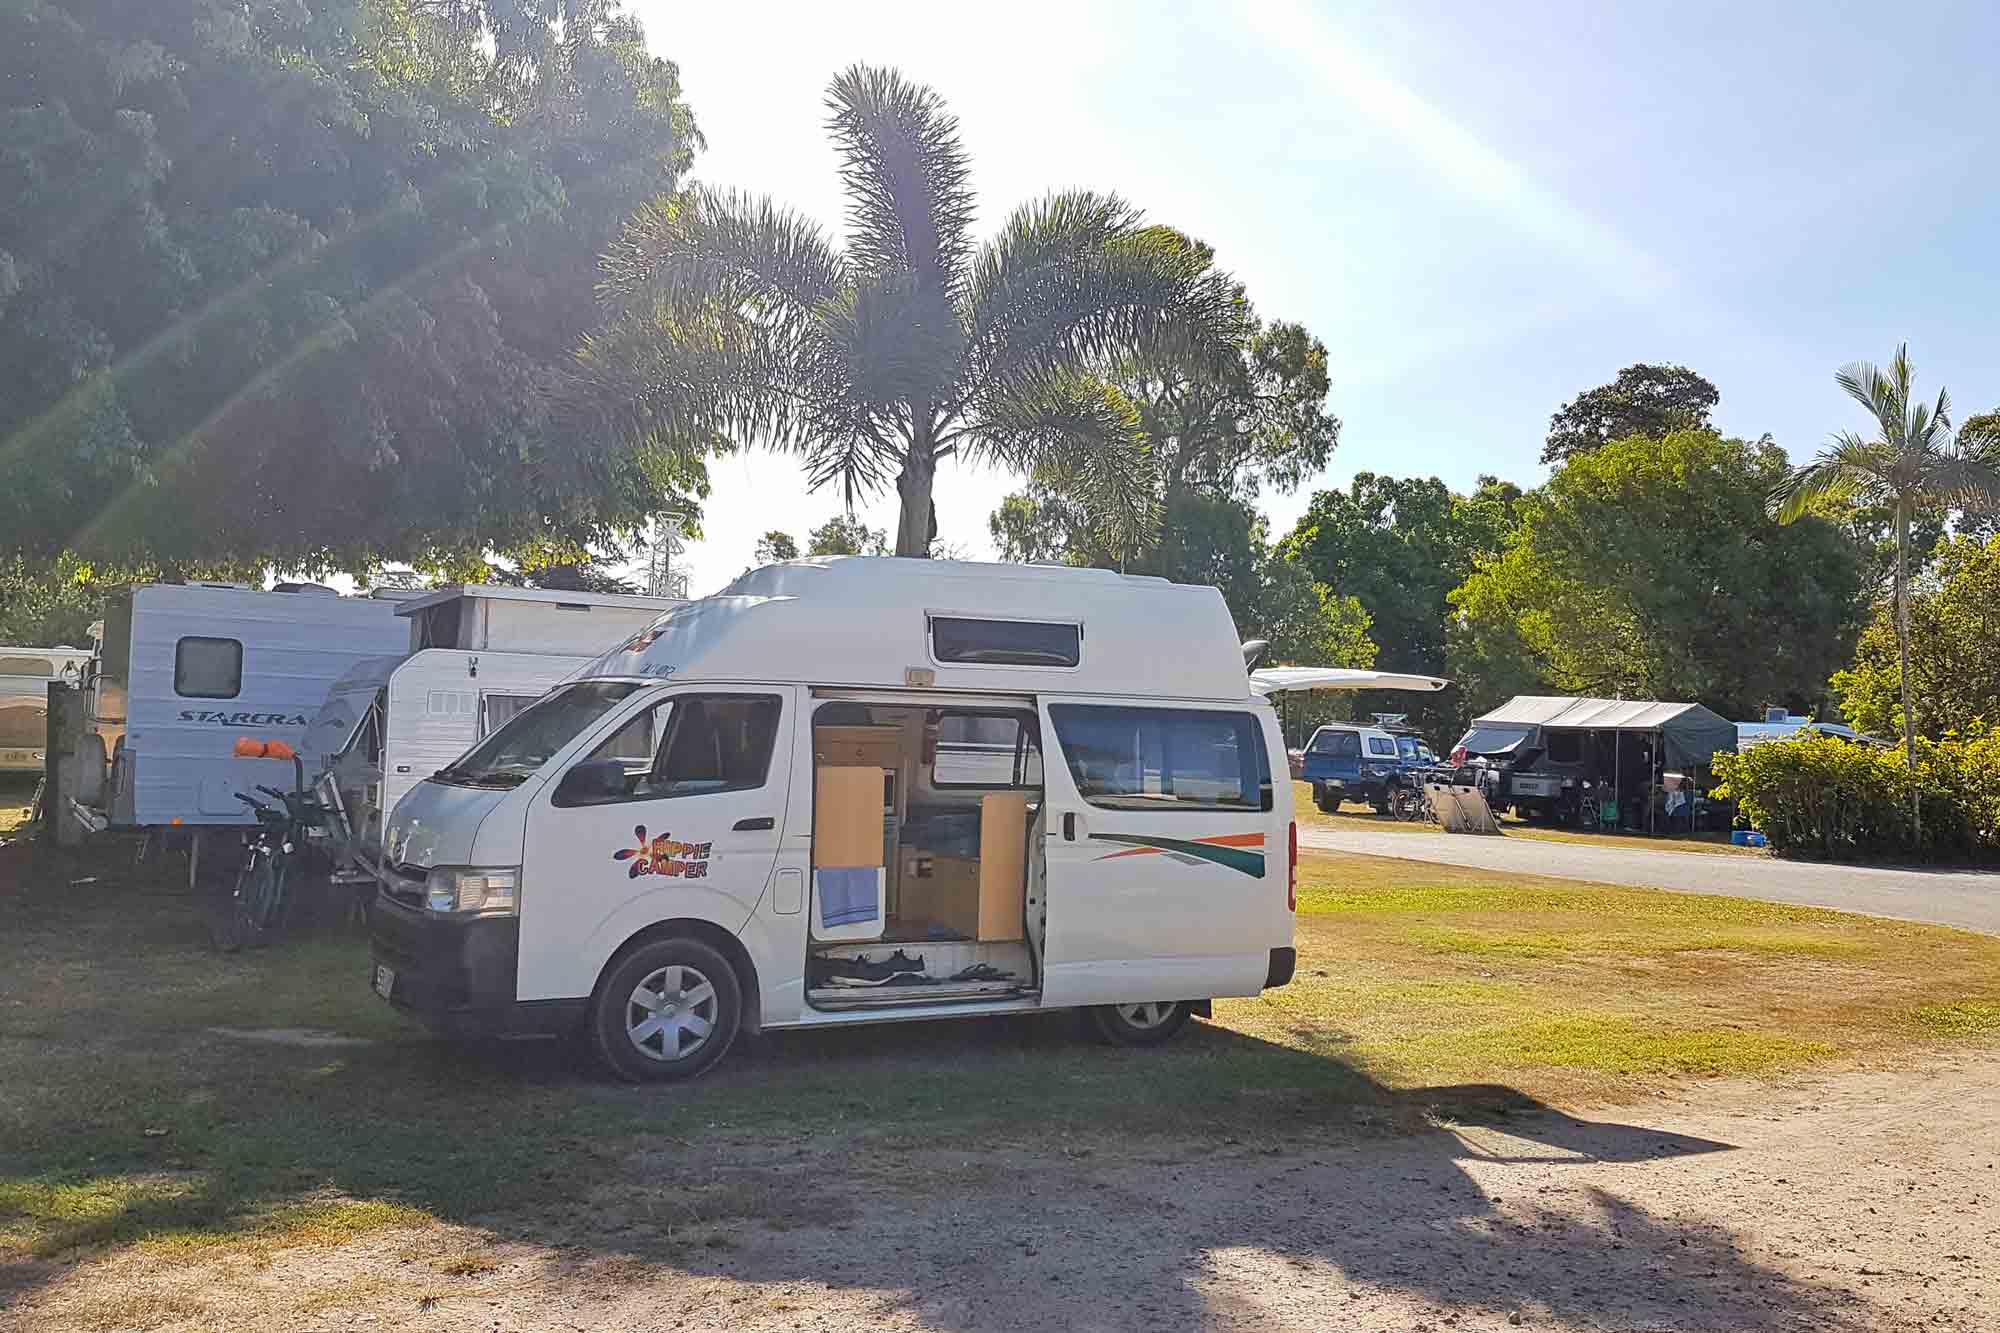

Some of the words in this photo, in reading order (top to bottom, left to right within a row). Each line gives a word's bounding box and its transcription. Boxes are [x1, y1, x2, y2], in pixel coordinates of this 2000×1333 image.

[177, 710, 308, 728] STARCRA
[652, 839, 712, 860] HIPPIE
[638, 858, 708, 878] CAMPER
